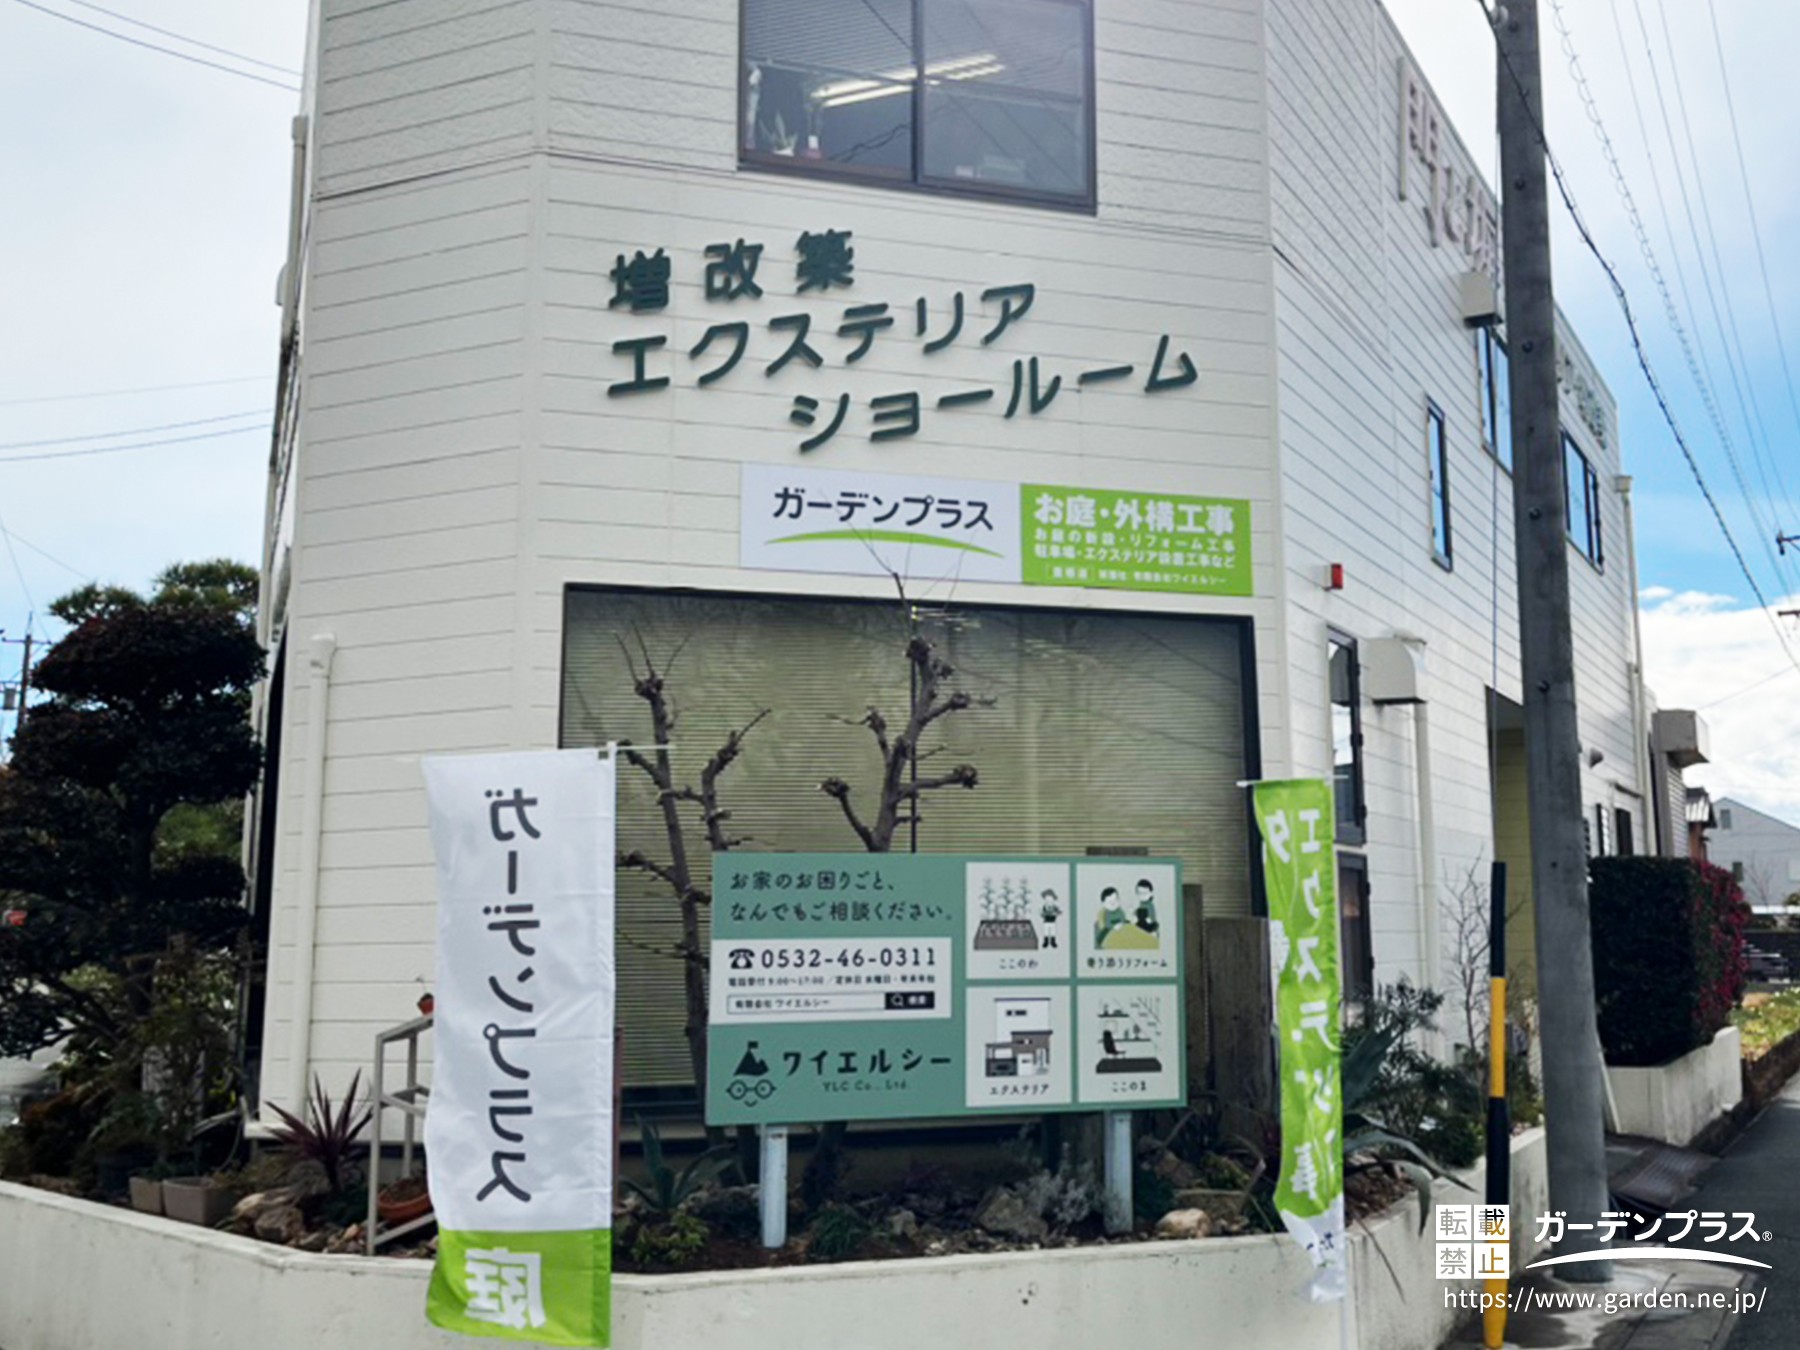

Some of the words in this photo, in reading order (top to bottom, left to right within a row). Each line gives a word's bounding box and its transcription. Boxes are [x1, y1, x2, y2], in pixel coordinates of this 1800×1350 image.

[608, 229, 855, 313] 増改築
[607, 284, 1036, 398] エクステリア
[789, 335, 1199, 453] ショールーム
[772, 486, 995, 532] ガーデンプラス
[1034, 492, 1235, 537] お庭・外構工事
[761, 947, 936, 969] 0532-46-0311
[783, 1048, 951, 1077] ワイエルシー
[822, 1081, 849, 1093] YLC
